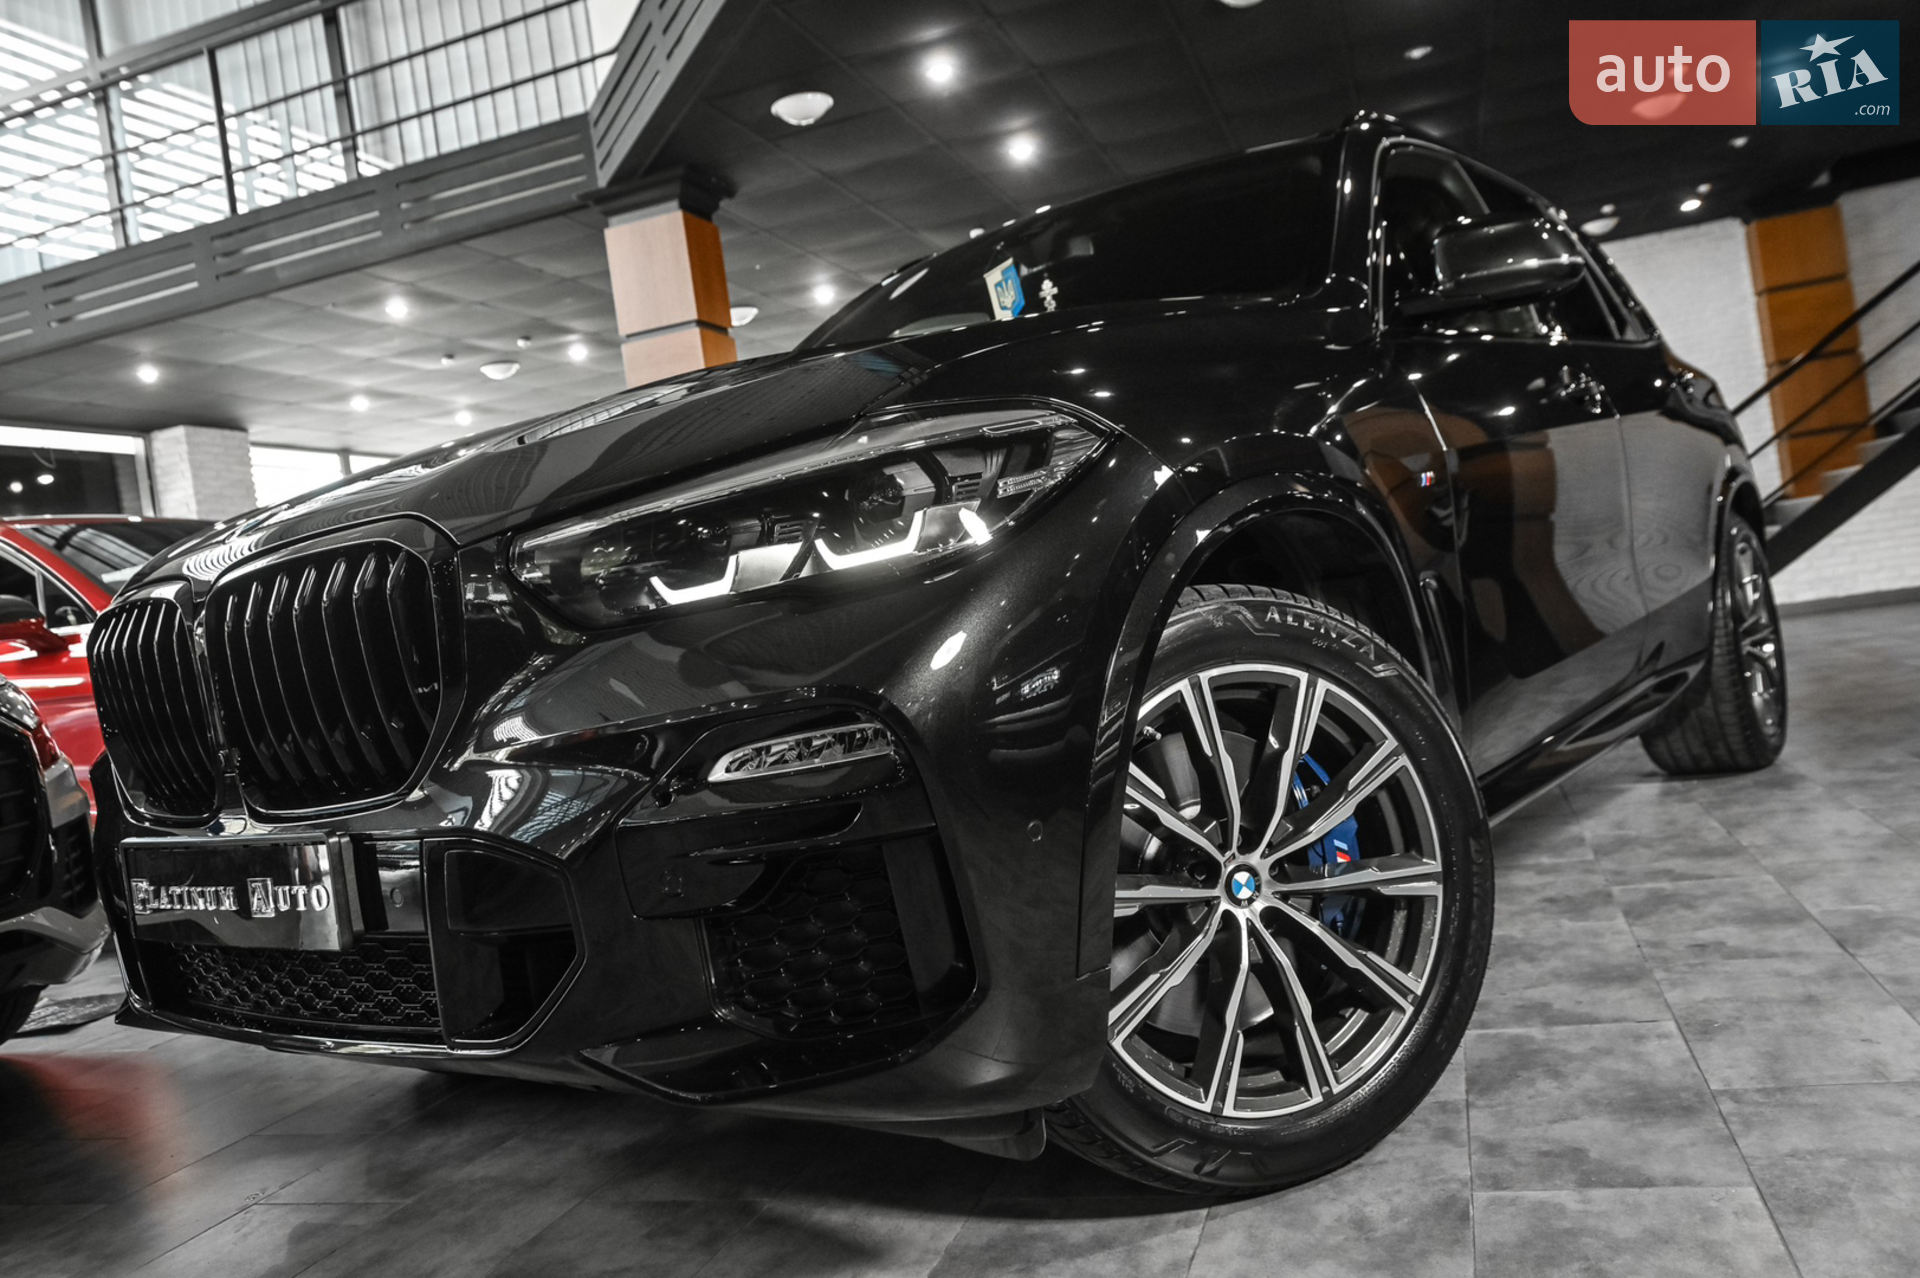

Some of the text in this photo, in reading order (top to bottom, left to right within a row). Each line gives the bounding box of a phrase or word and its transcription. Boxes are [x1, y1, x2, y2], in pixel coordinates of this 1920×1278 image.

[1264, 605, 1375, 661] ALENZA
[131, 878, 330, 918] PLATINUM AUTO
